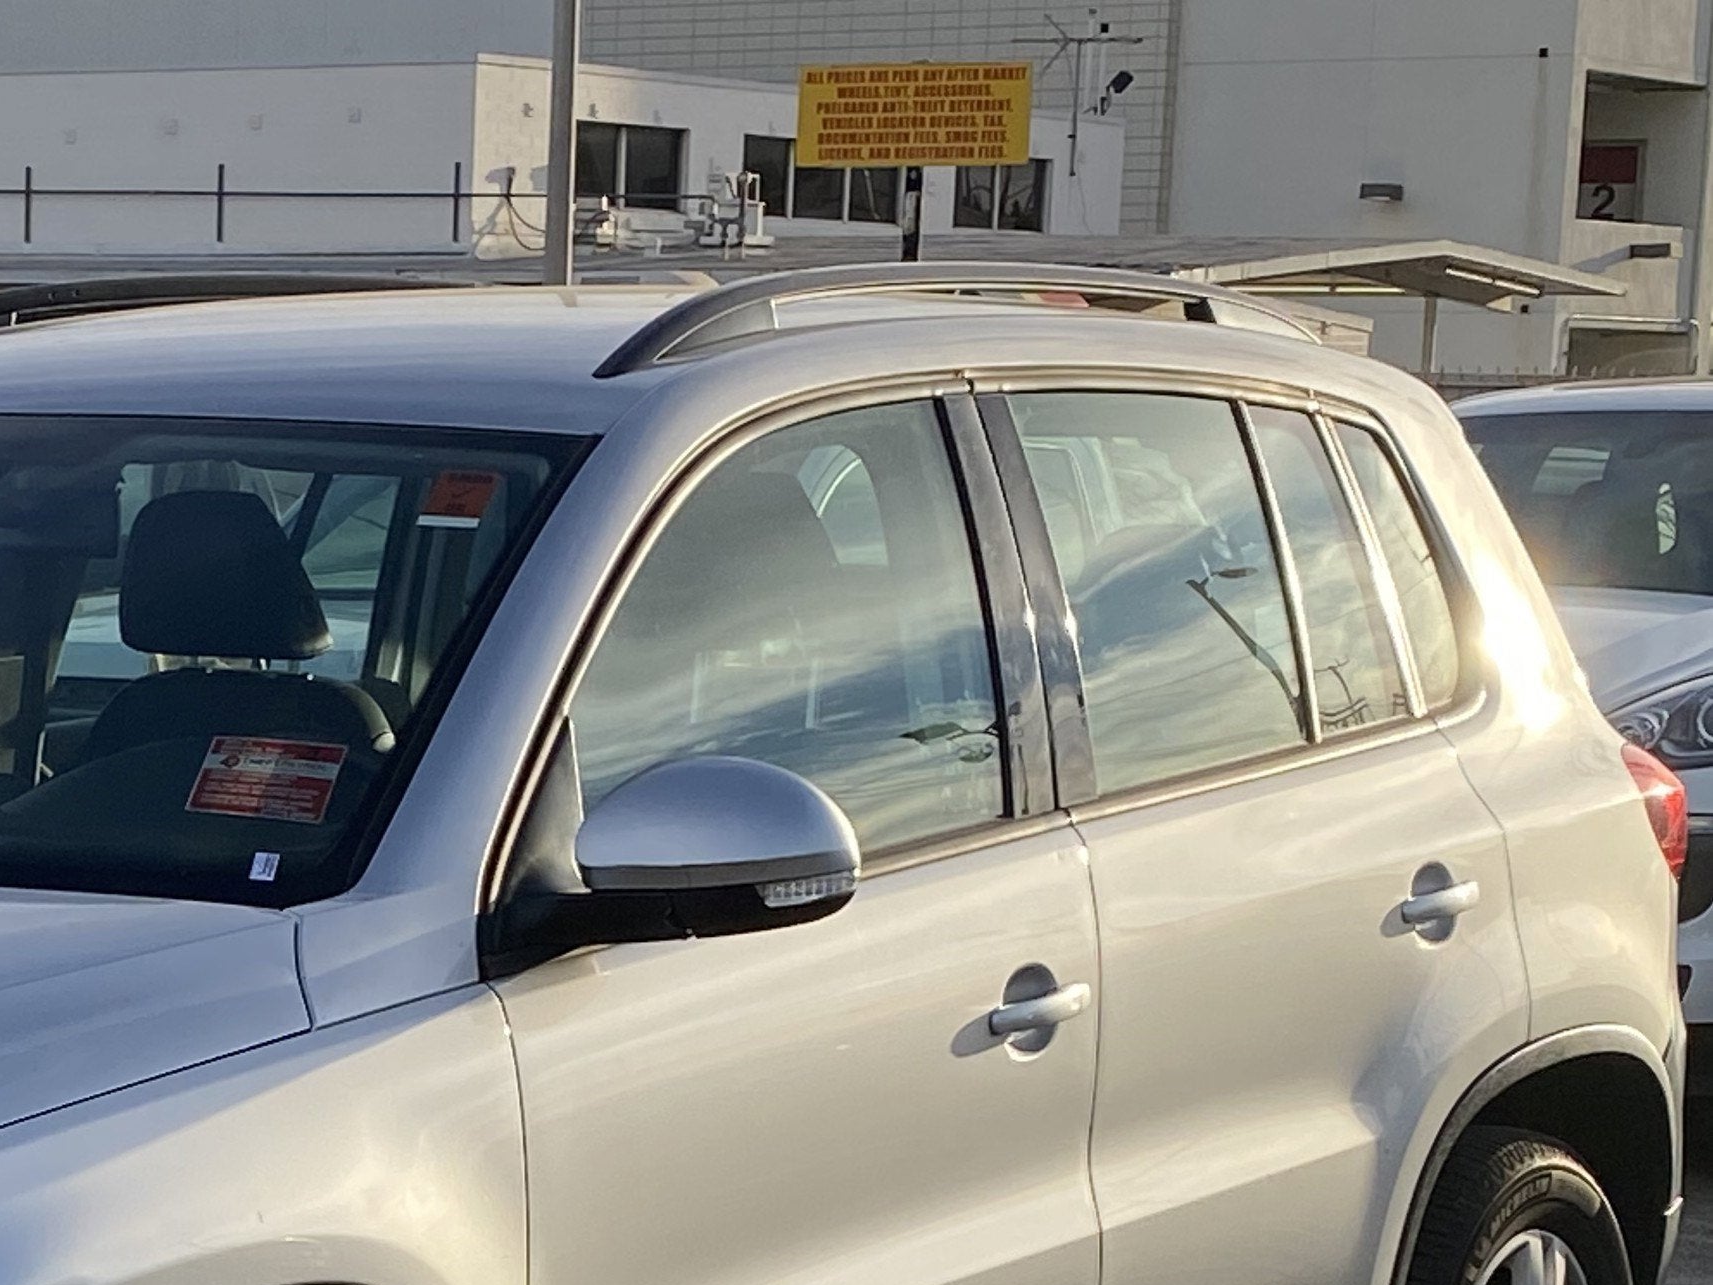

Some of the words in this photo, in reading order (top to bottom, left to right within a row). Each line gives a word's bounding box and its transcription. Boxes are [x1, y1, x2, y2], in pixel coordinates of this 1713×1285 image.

[805, 72, 824, 84] ALL
[827, 71, 865, 83] PRICES
[869, 71, 889, 82] ARE
[892, 70, 919, 82] PLUS
[923, 69, 943, 81] ANY
[947, 68, 979, 81] AFTER
[983, 67, 1027, 80] MARKET
[876, 115, 926, 129] LOCATOR
[817, 132, 910, 145] DOCUMENTATION
[945, 130, 977, 143] SMOG
[868, 147, 891, 159] AND
[894, 146, 974, 159] REGISTRATION
[1590, 184, 1615, 219] 2
